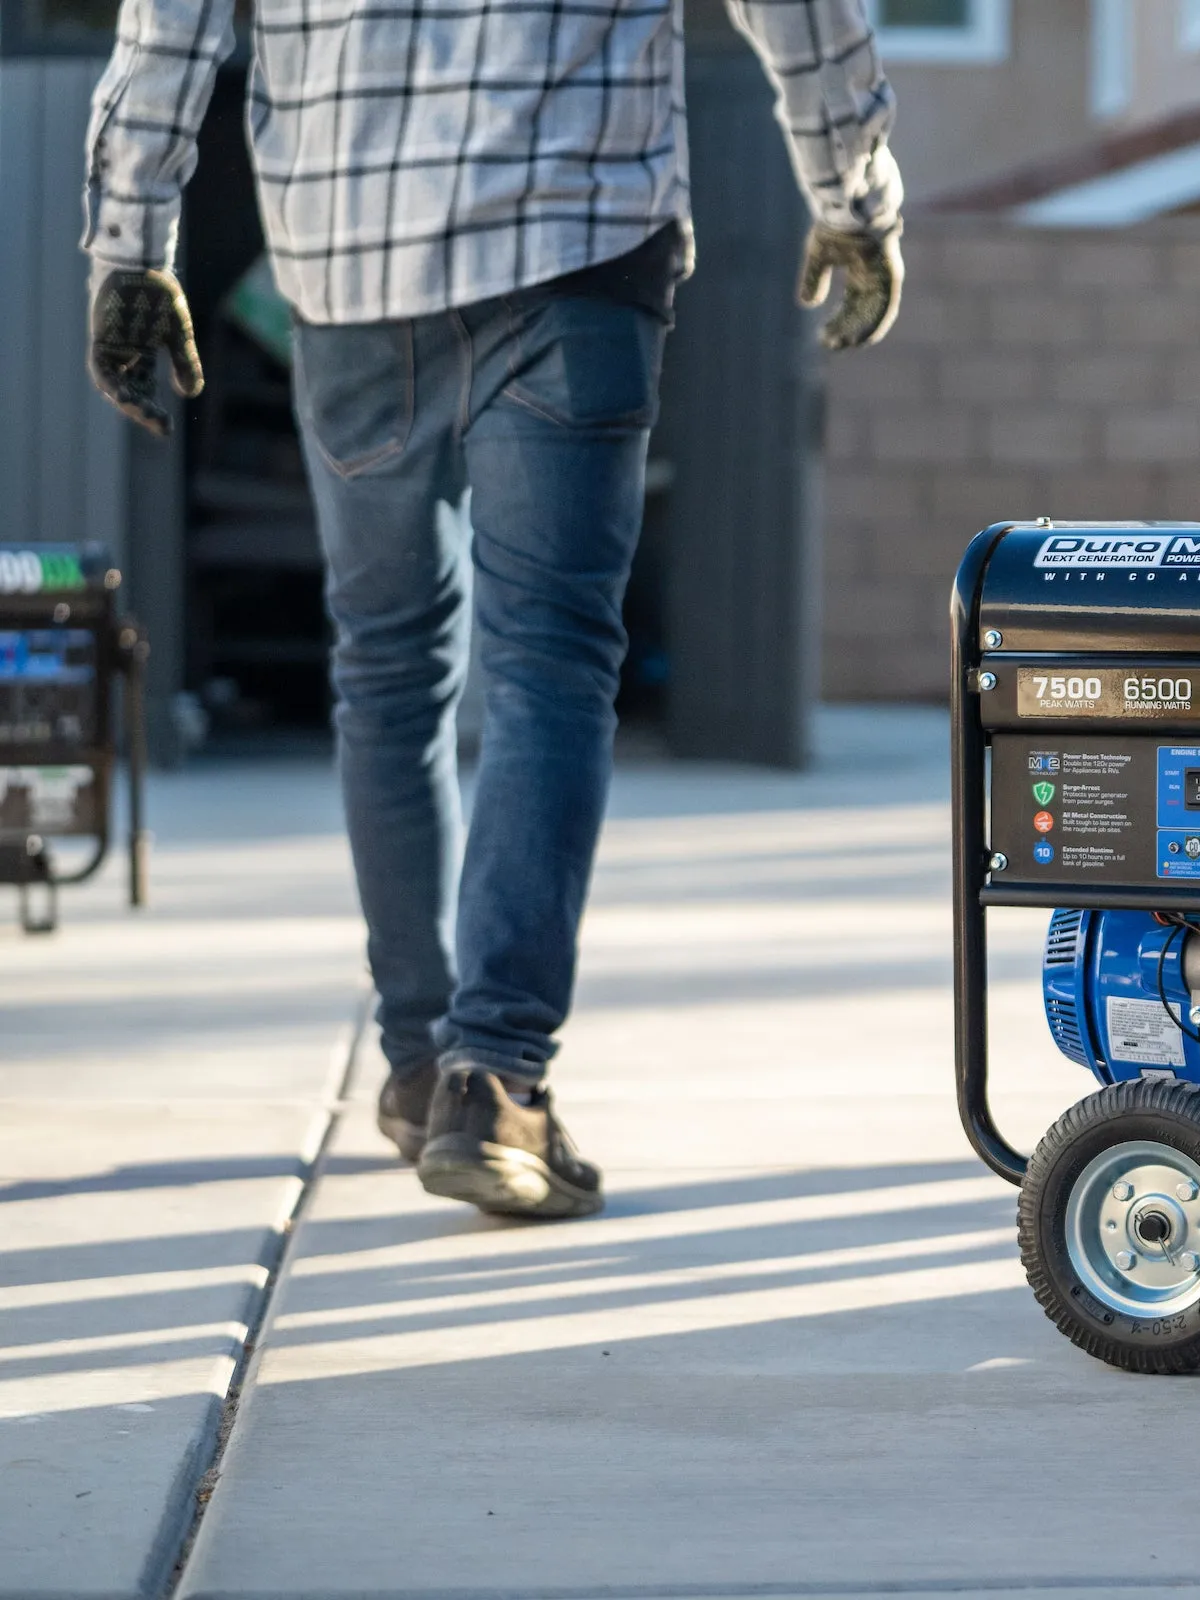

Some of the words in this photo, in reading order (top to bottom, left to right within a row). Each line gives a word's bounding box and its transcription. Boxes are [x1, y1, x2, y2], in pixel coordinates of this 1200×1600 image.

[1044, 573, 1105, 581] WITH
[1129, 573, 1155, 581] CO
[1032, 677, 1101, 699] 7500
[1123, 678, 1192, 700] 6500
[1040, 700, 1062, 708] PEAK
[1065, 700, 1095, 708] WATTS
[1125, 701, 1161, 709] RUNNING
[1163, 701, 1191, 710] WATTS
[1100, 754, 1131, 762] Technology
[1037, 848, 1050, 857] 10
